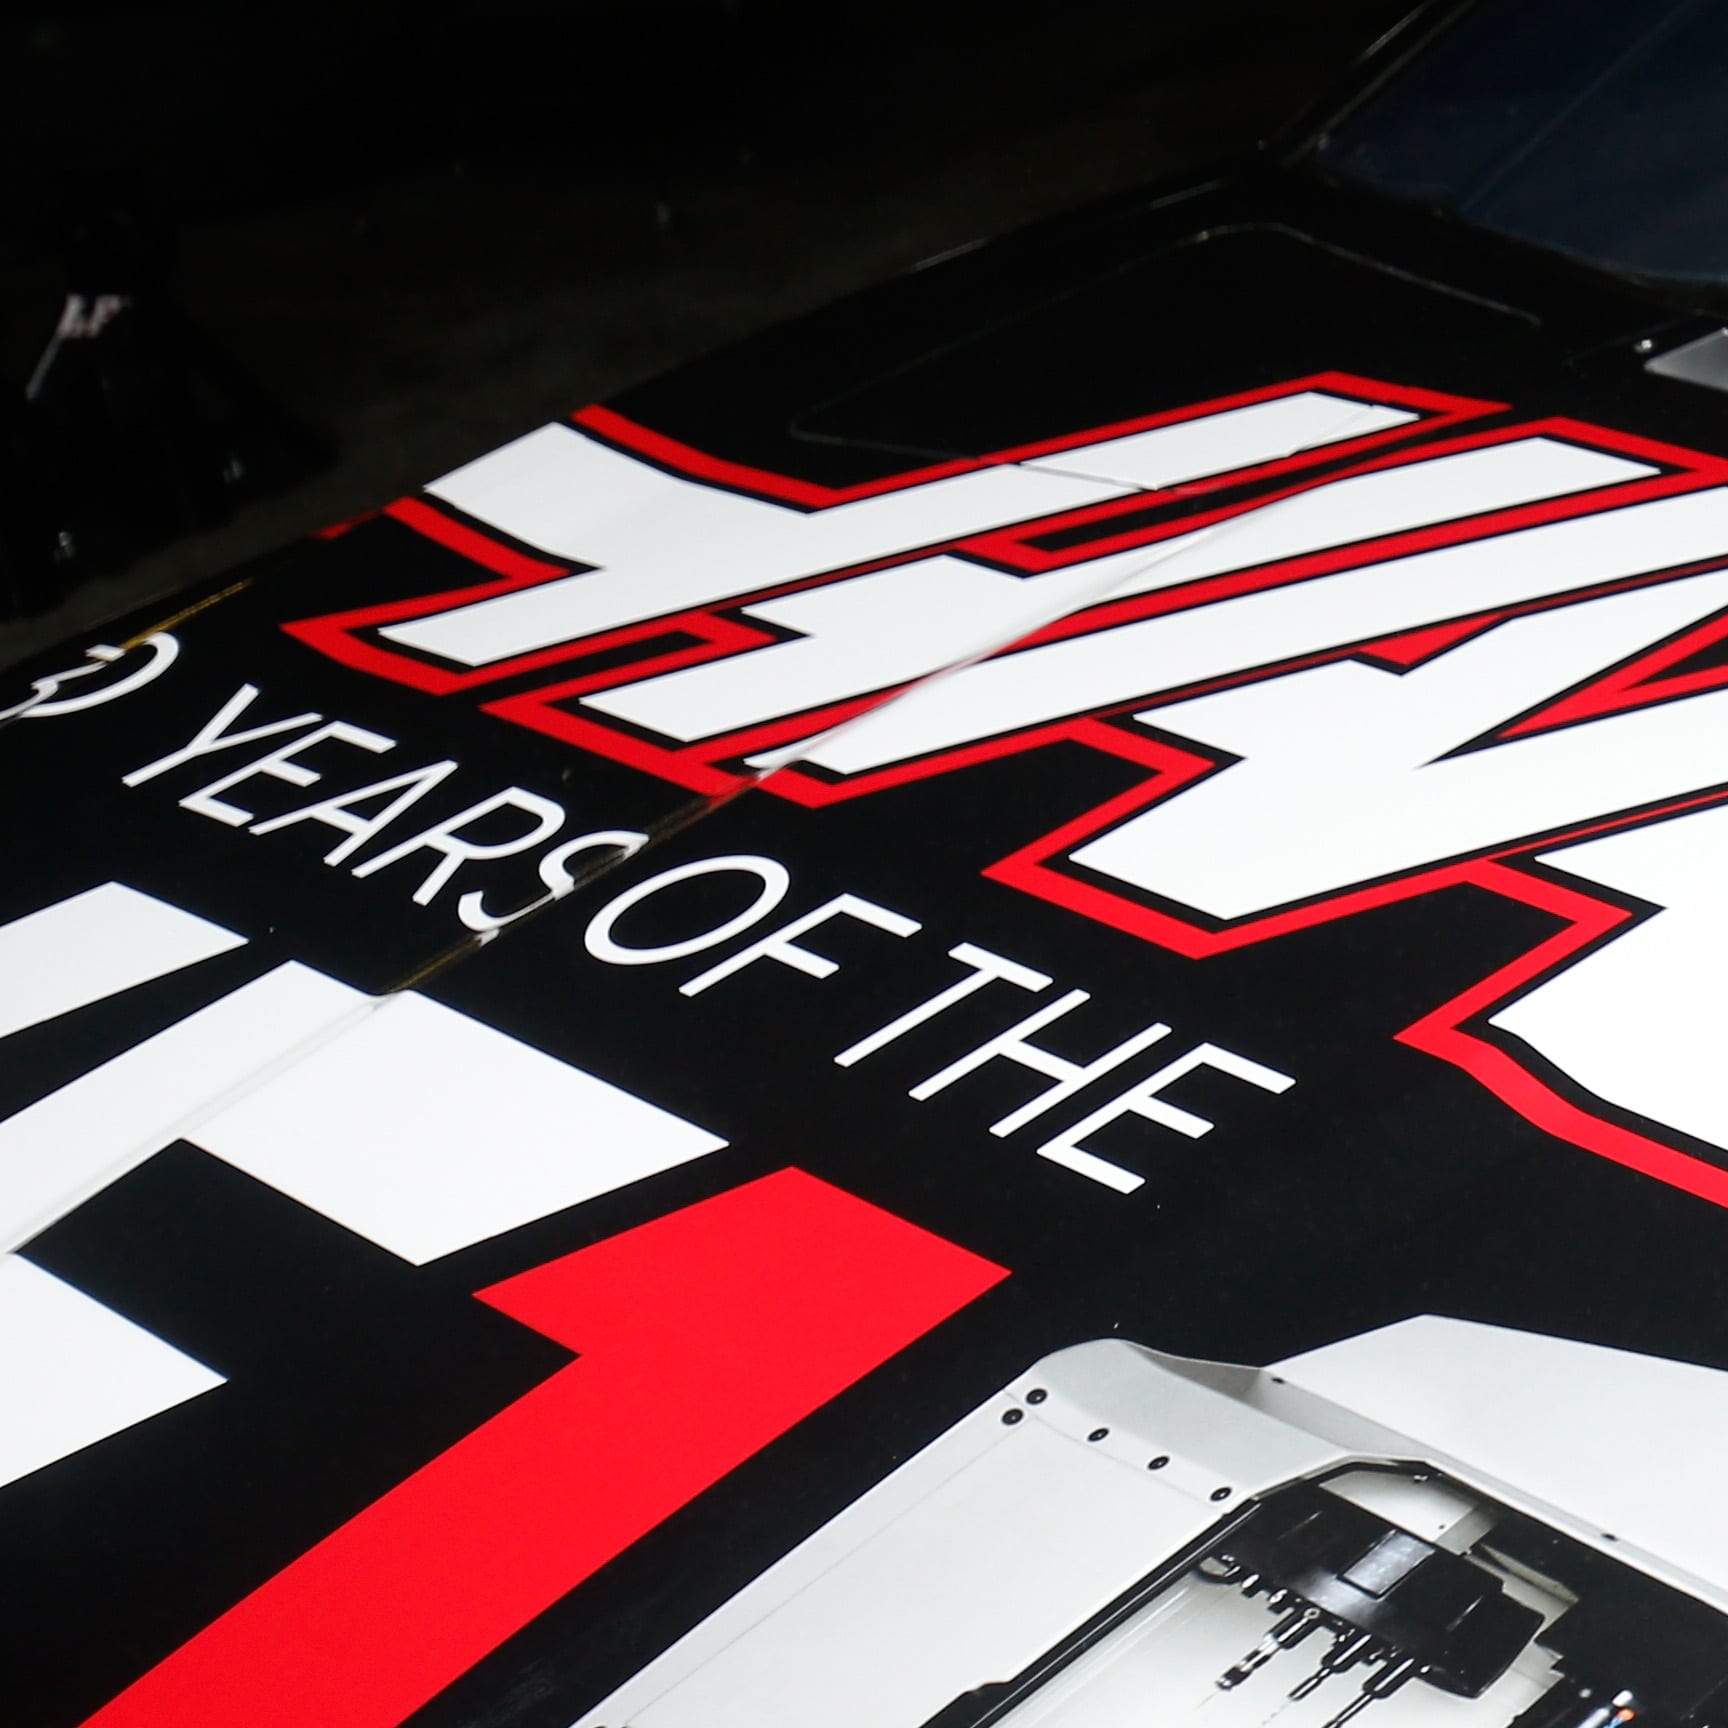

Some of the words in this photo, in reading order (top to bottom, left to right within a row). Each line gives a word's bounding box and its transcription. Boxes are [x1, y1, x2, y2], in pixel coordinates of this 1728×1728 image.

[121, 683, 648, 946] YEARS
[584, 854, 922, 997] OF
[834, 941, 1296, 1195] THE
